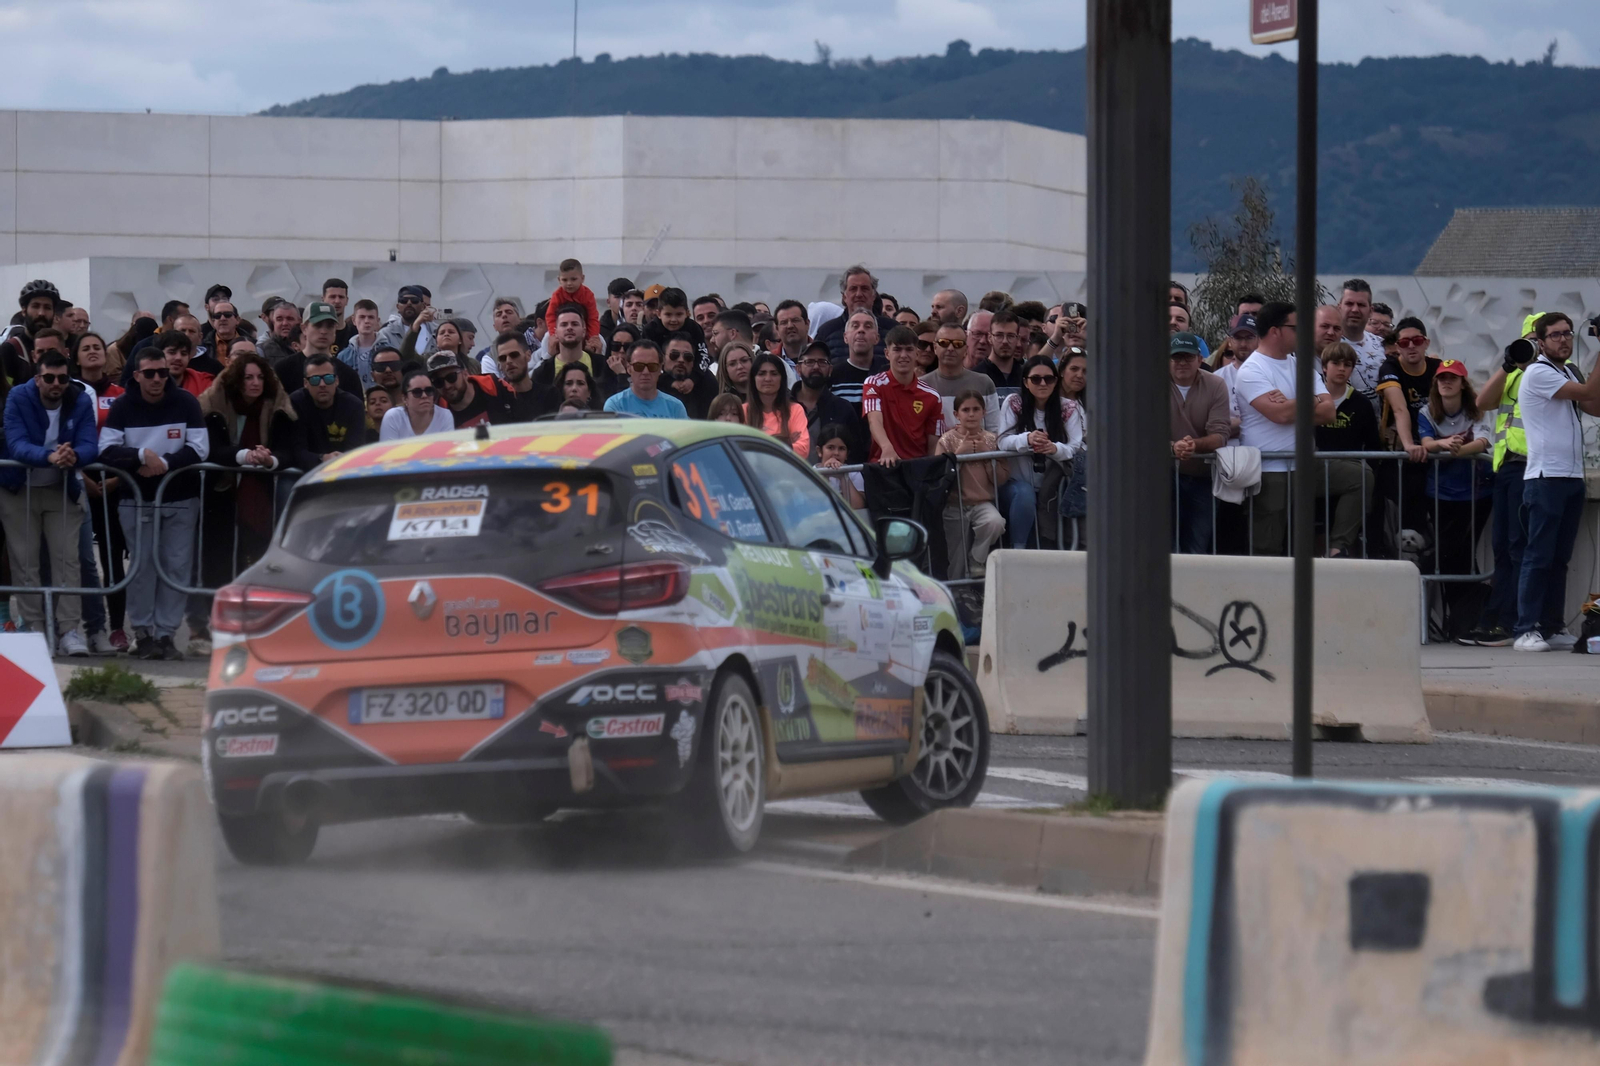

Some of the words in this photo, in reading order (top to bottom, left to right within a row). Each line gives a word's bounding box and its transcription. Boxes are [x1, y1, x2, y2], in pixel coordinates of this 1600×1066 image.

[421, 485, 490, 500] RADSA
[540, 481, 599, 516] 31
[673, 462, 717, 519] 31
[606, 716, 662, 736] Castrol
[228, 736, 276, 755] Castrol
